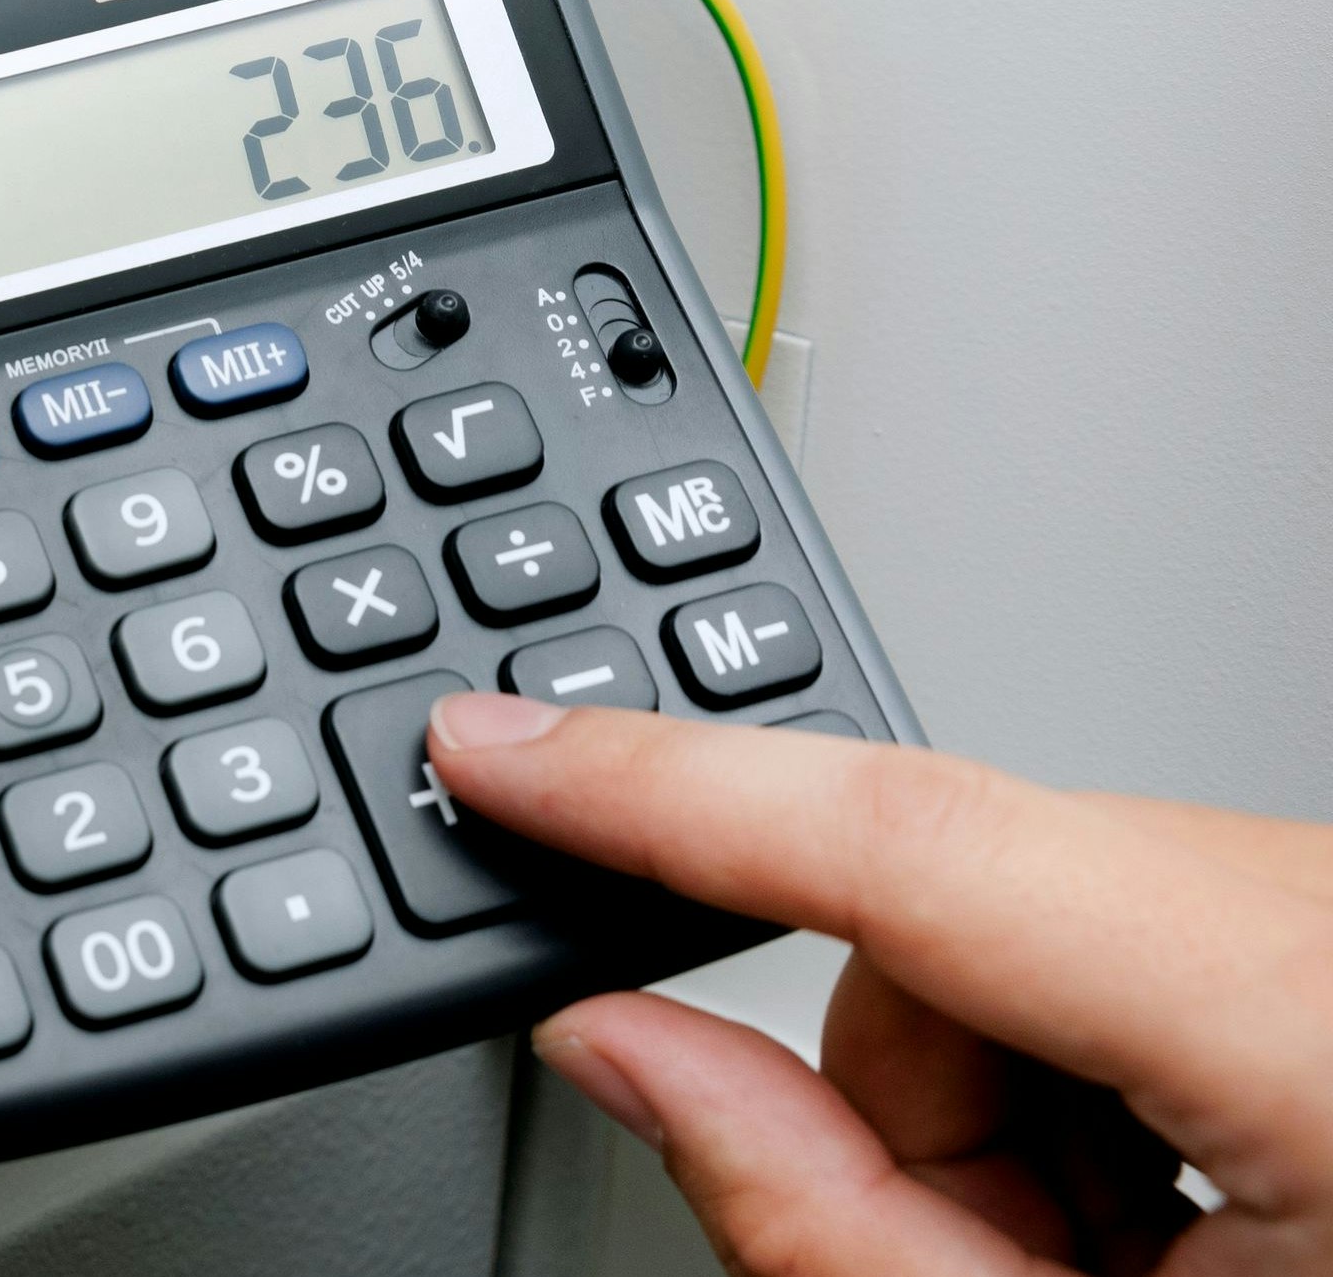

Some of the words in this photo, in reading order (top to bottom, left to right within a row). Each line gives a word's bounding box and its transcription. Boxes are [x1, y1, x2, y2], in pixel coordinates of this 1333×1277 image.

[324, 293, 361, 325] CUT
[359, 274, 386, 300] UP
[388, 250, 424, 282] 5/4
[537, 287, 556, 308] A
[558, 340, 576, 358] 2
[570, 360, 586, 380] 4
[579, 385, 597, 408] F
[120, 493, 168, 547] 9
[171, 616, 221, 672] 6
[4, 658, 53, 715] 5
[220, 745, 272, 802] 3
[53, 791, 107, 851] 2
[81, 919, 175, 991] 00
